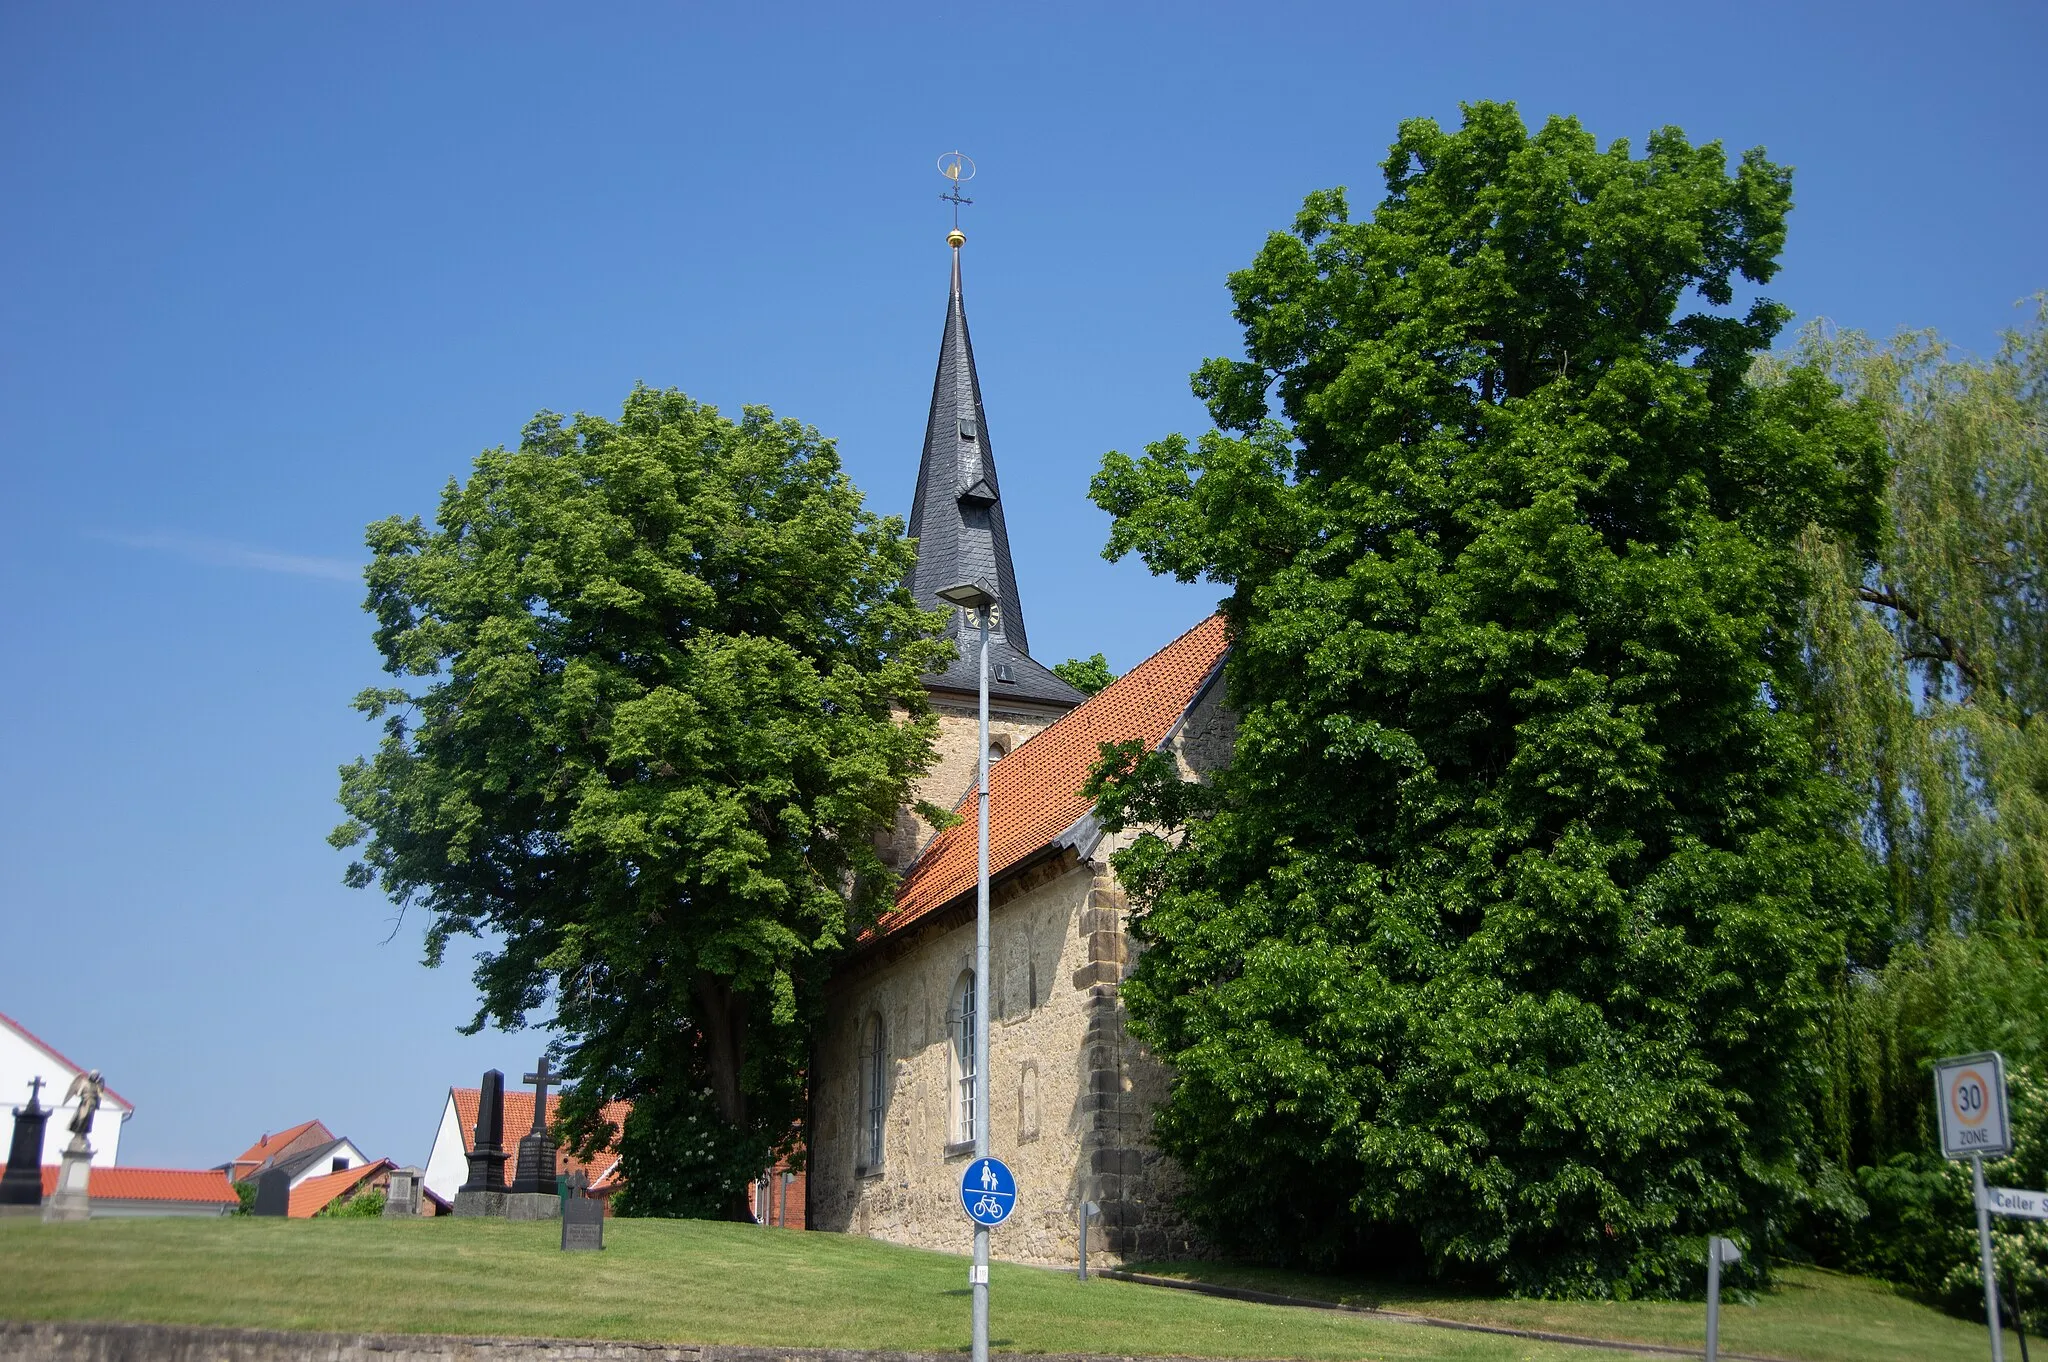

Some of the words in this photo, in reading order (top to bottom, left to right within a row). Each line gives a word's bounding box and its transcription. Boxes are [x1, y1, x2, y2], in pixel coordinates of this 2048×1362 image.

[1958, 1084, 1981, 1112] 30
[1959, 1128, 1989, 1145] ZONE
[1997, 1193, 2035, 1210] Celler
